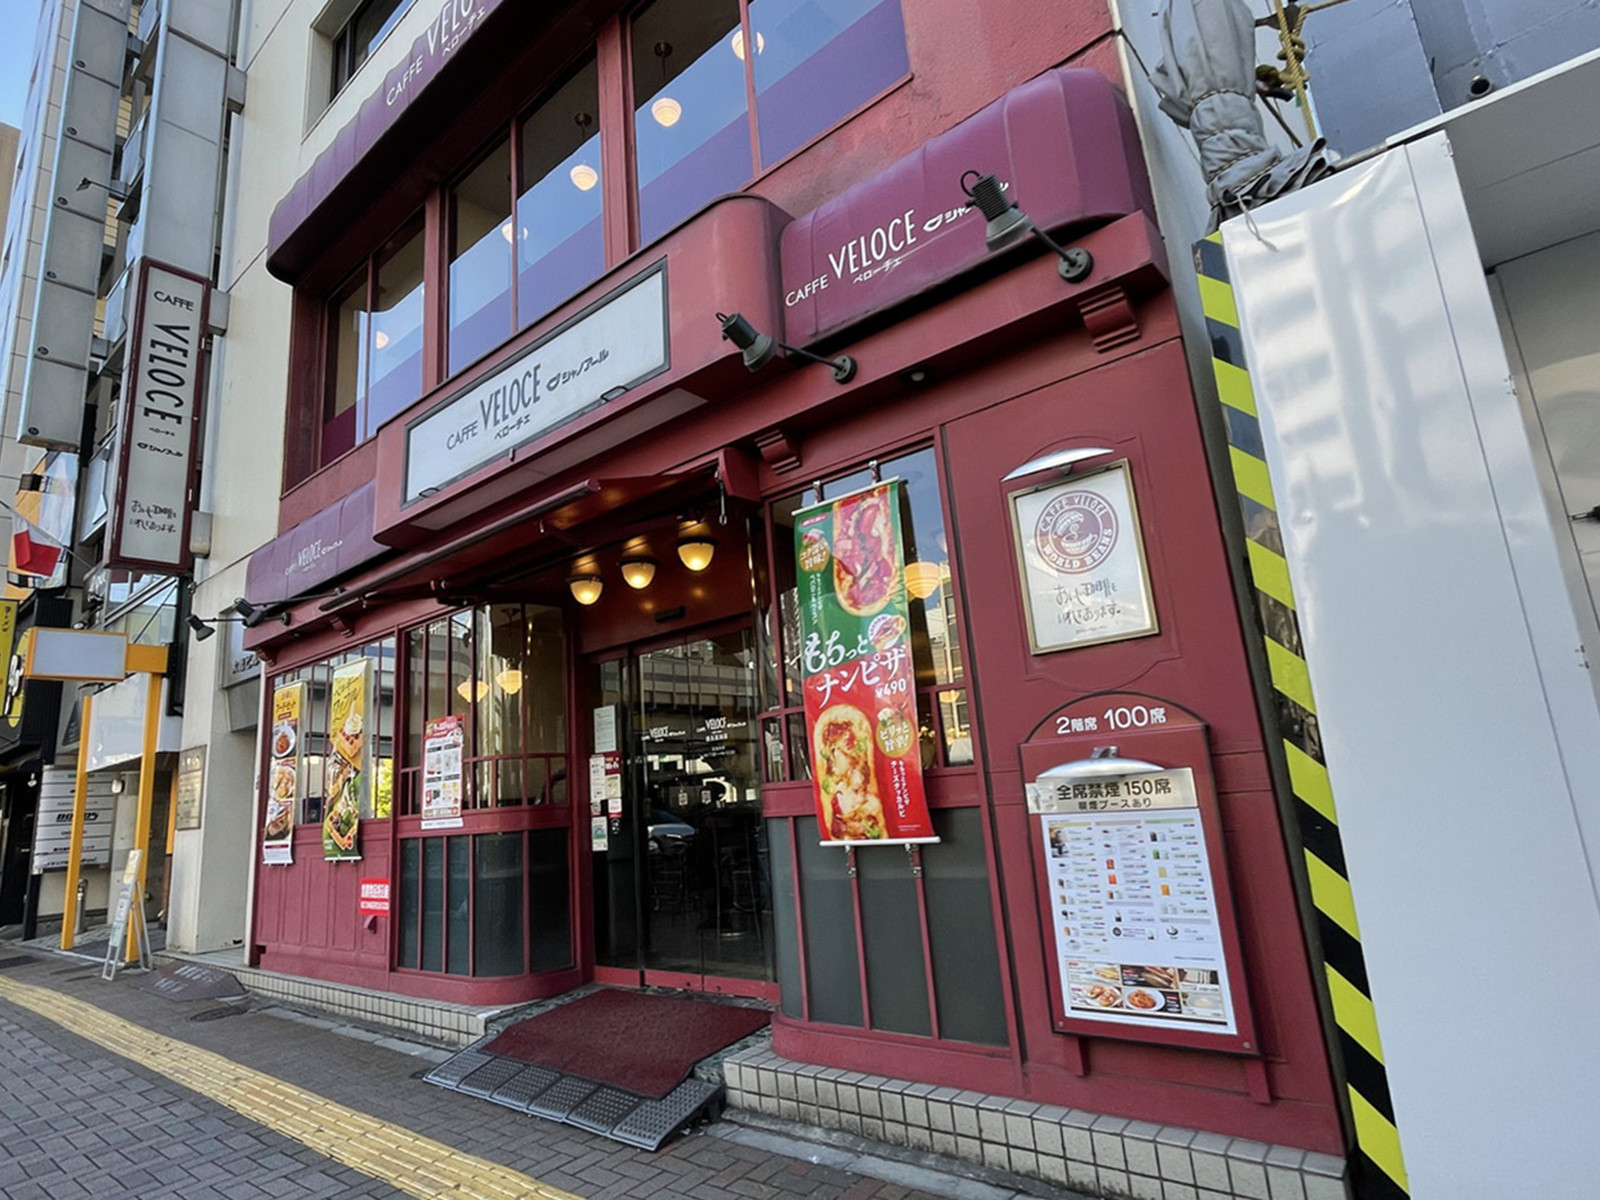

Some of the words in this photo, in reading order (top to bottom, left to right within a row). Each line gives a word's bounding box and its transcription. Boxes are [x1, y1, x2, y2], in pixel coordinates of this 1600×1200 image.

[386, 54, 423, 106] CAFFE
[785, 274, 829, 307] CAFFE
[828, 209, 917, 280] VELOCE
[853, 257, 903, 284] ベローチェ
[153, 290, 194, 312] CAFFE
[143, 323, 190, 425] VELOCE
[446, 420, 478, 451] CAFFE
[480, 363, 542, 431] VELOCE
[561, 349, 610, 388] シャノアール
[494, 413, 531, 440] ベローチェ
[1040, 498, 1069, 532] CAFFE
[1043, 544, 1081, 569] WORLD
[1083, 527, 1113, 566] BEANS
[804, 630, 869, 673] もちっと
[816, 644, 907, 708] ナンピザ
[875, 678, 907, 699] ¥490
[1056, 716, 1098, 735] 2階席
[1103, 705, 1167, 731] 100席
[1056, 781, 1121, 800] 全席禁煙
[1124, 778, 1172, 796] 150席
